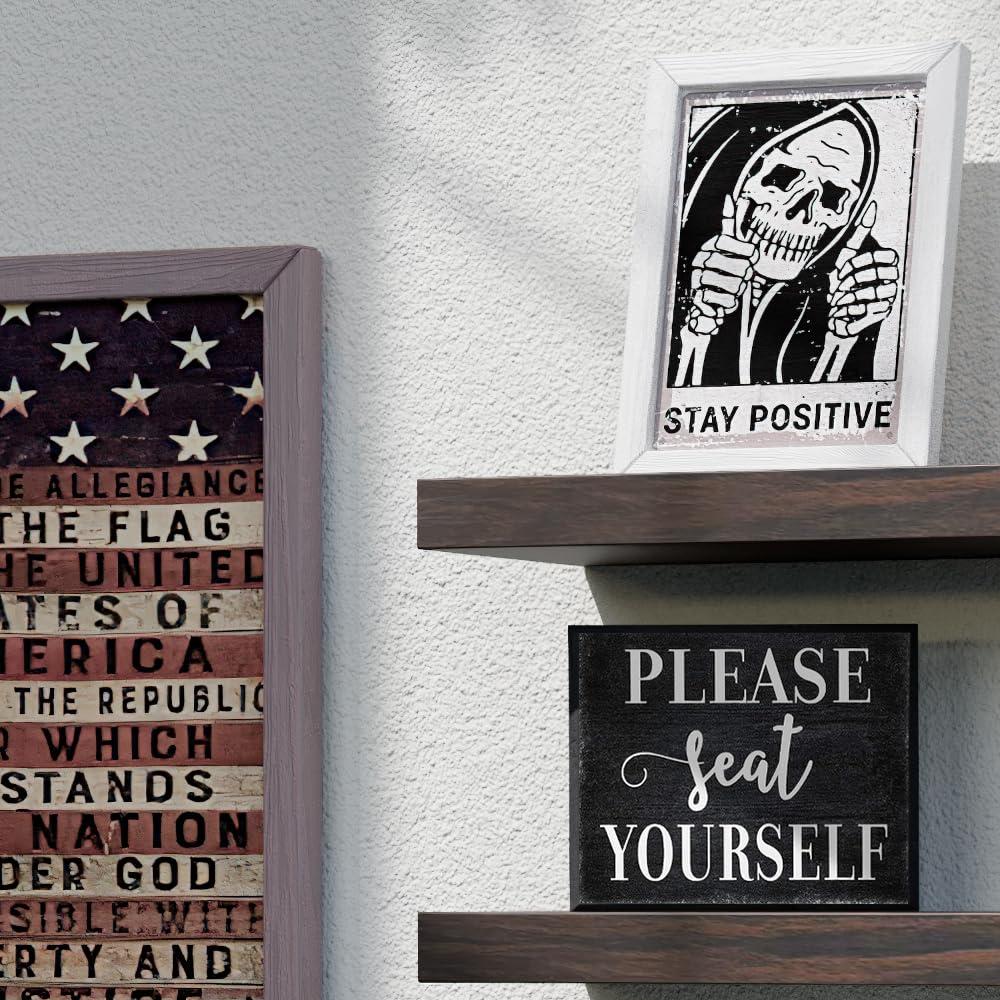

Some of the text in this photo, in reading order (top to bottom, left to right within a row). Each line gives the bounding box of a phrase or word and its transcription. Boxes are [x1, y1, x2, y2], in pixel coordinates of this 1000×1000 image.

[663, 400, 892, 434] STAY POSITIVE
[0, 469, 264, 499] E ALLEGIANCE
[107, 507, 231, 544] FLAG
[78, 549, 264, 587] UNITED
[156, 592, 223, 631] OF
[0, 636, 213, 676] ERICA
[625, 647, 872, 704] PLEASE
[14, 687, 78, 716] THE
[41, 723, 213, 762] WHICH
[621, 713, 813, 812] seat
[1, 769, 213, 804] STANDS
[31, 811, 248, 850] NATION
[600, 823, 888, 882] YOURSELF
[116, 856, 216, 891] GOD
[0, 901, 130, 933] SIBLE
[0, 944, 232, 980] RTY AND
